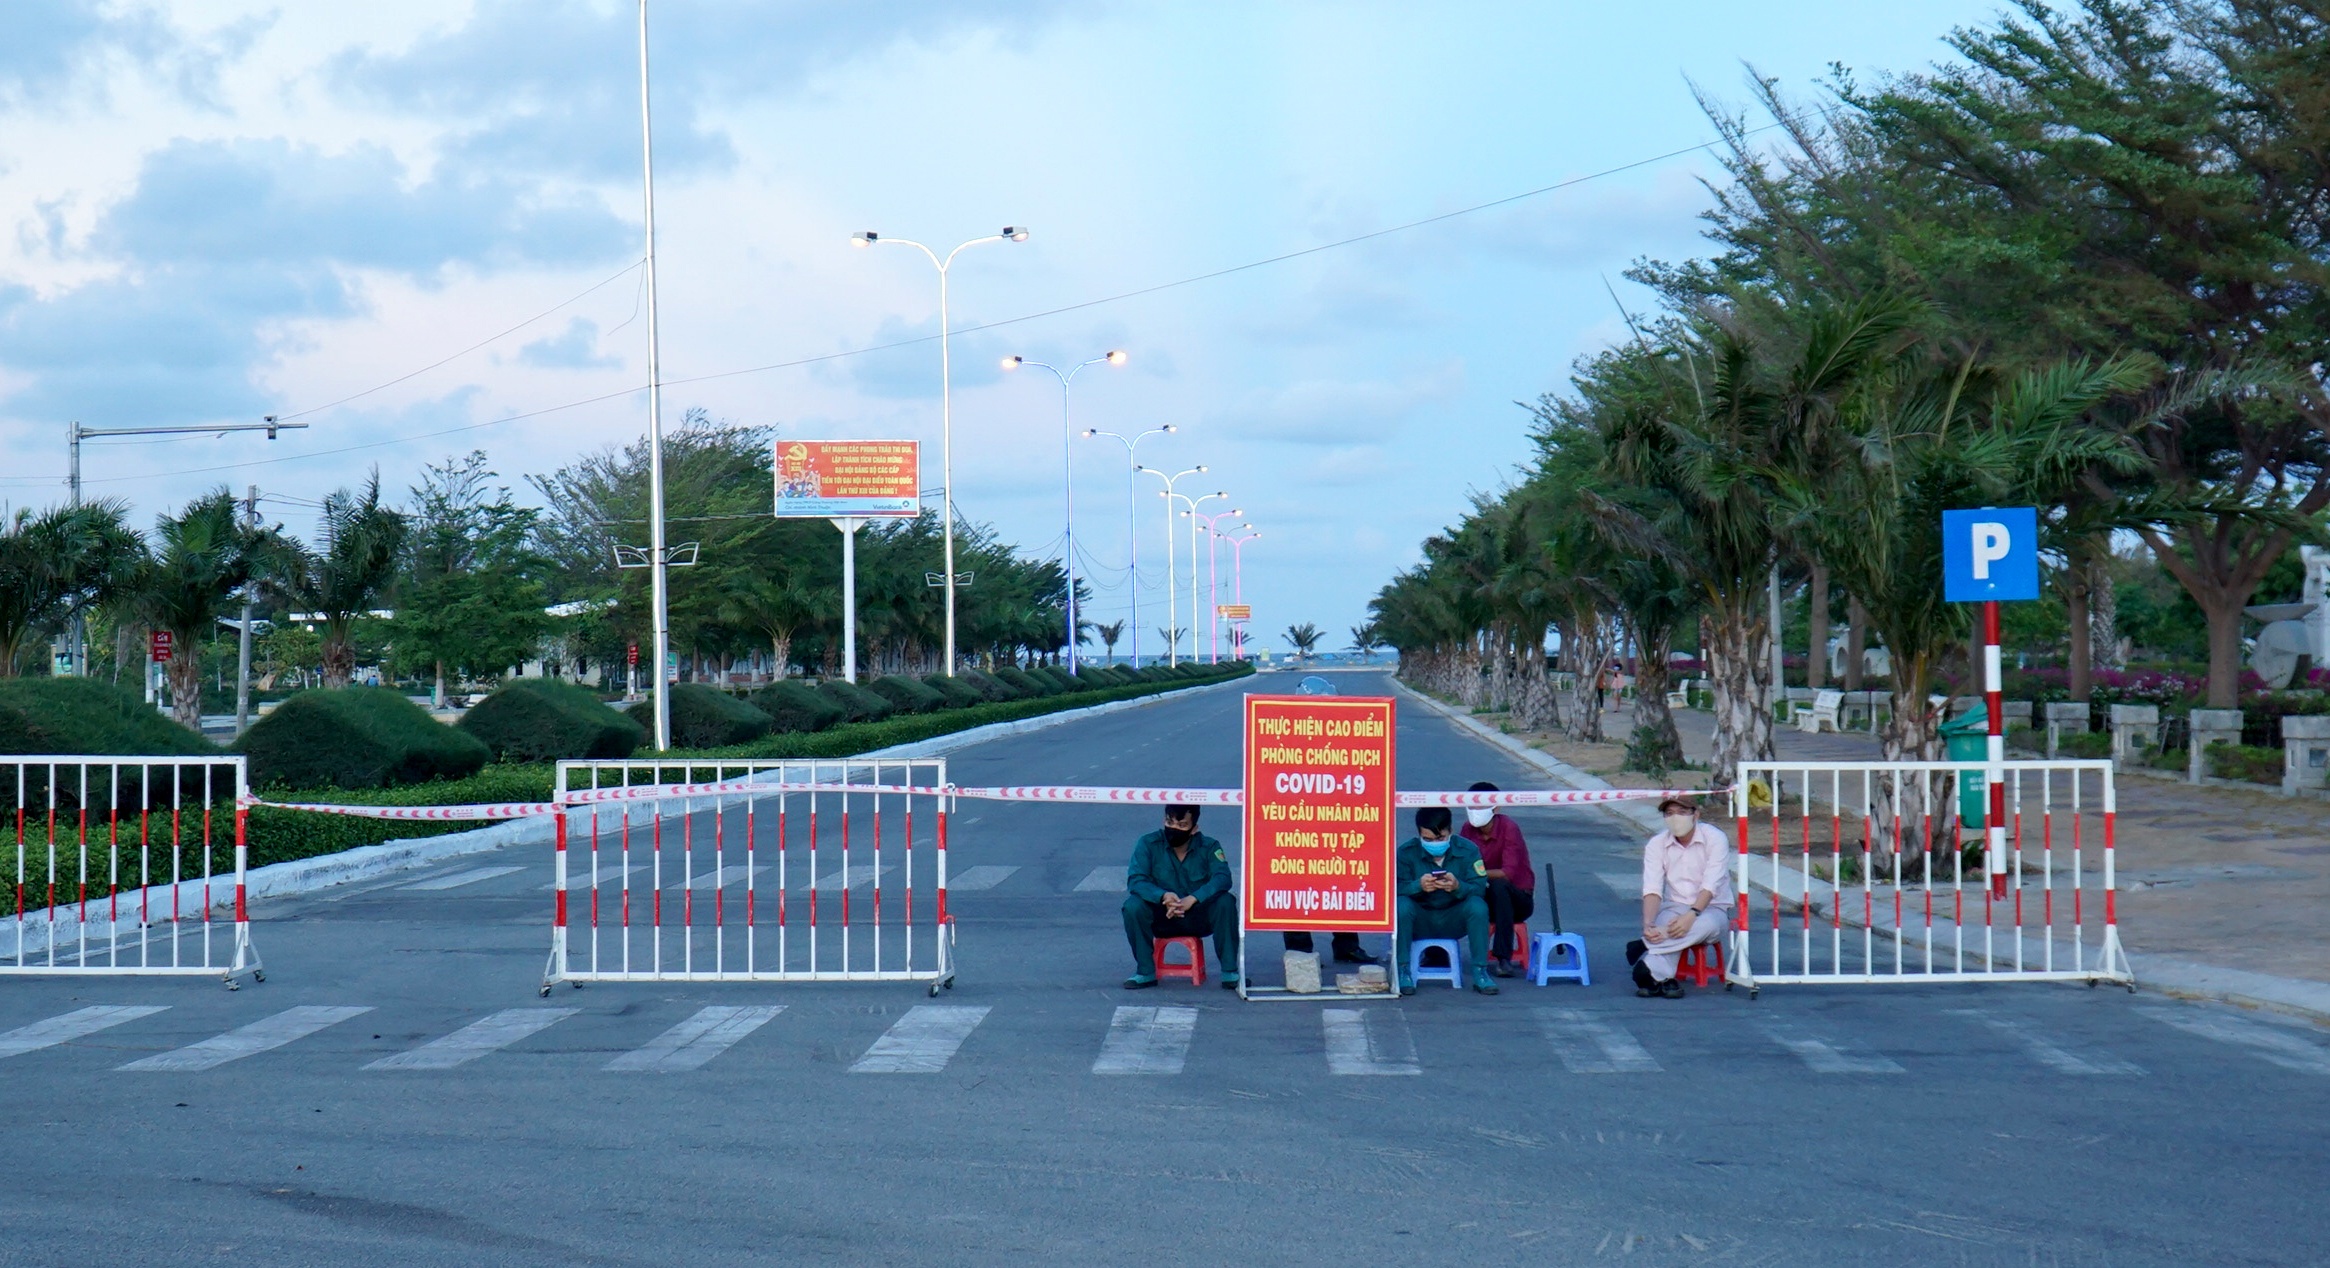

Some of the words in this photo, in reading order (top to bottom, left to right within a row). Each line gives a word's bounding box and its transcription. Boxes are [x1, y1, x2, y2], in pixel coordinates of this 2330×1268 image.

[849, 445, 859, 453] CÁC
[873, 455, 886, 463] CHÀO
[1972, 522, 2011, 580] P
[1258, 716, 1291, 740] THỰC
[1294, 716, 1323, 740] HIỆN
[1326, 720, 1351, 737] CAO
[1354, 713, 1384, 737] ĐIỂM
[1261, 745, 1303, 764] PHÒNG
[1306, 743, 1348, 766] CHỐNG
[1351, 750, 1380, 771] DỊCH
[1276, 773, 1366, 794] COVID-19
[1262, 800, 1286, 821] YÊU
[1289, 799, 1313, 821] CẦU
[1317, 802, 1350, 821] NHÂN
[1354, 802, 1379, 822] DÂN
[1276, 830, 1318, 848] KHÔNG
[1322, 834, 1337, 852] TỤ
[1341, 830, 1365, 853] TẬP
[1271, 856, 1305, 875] ĐÔNG
[1308, 857, 1346, 875] NGƯỜI
[1349, 860, 1369, 880] TẠI
[1266, 890, 1292, 910] KHU
[1295, 887, 1319, 915] VỰC
[1322, 885, 1342, 910] BÃI
[1346, 882, 1374, 911] BIỂN
